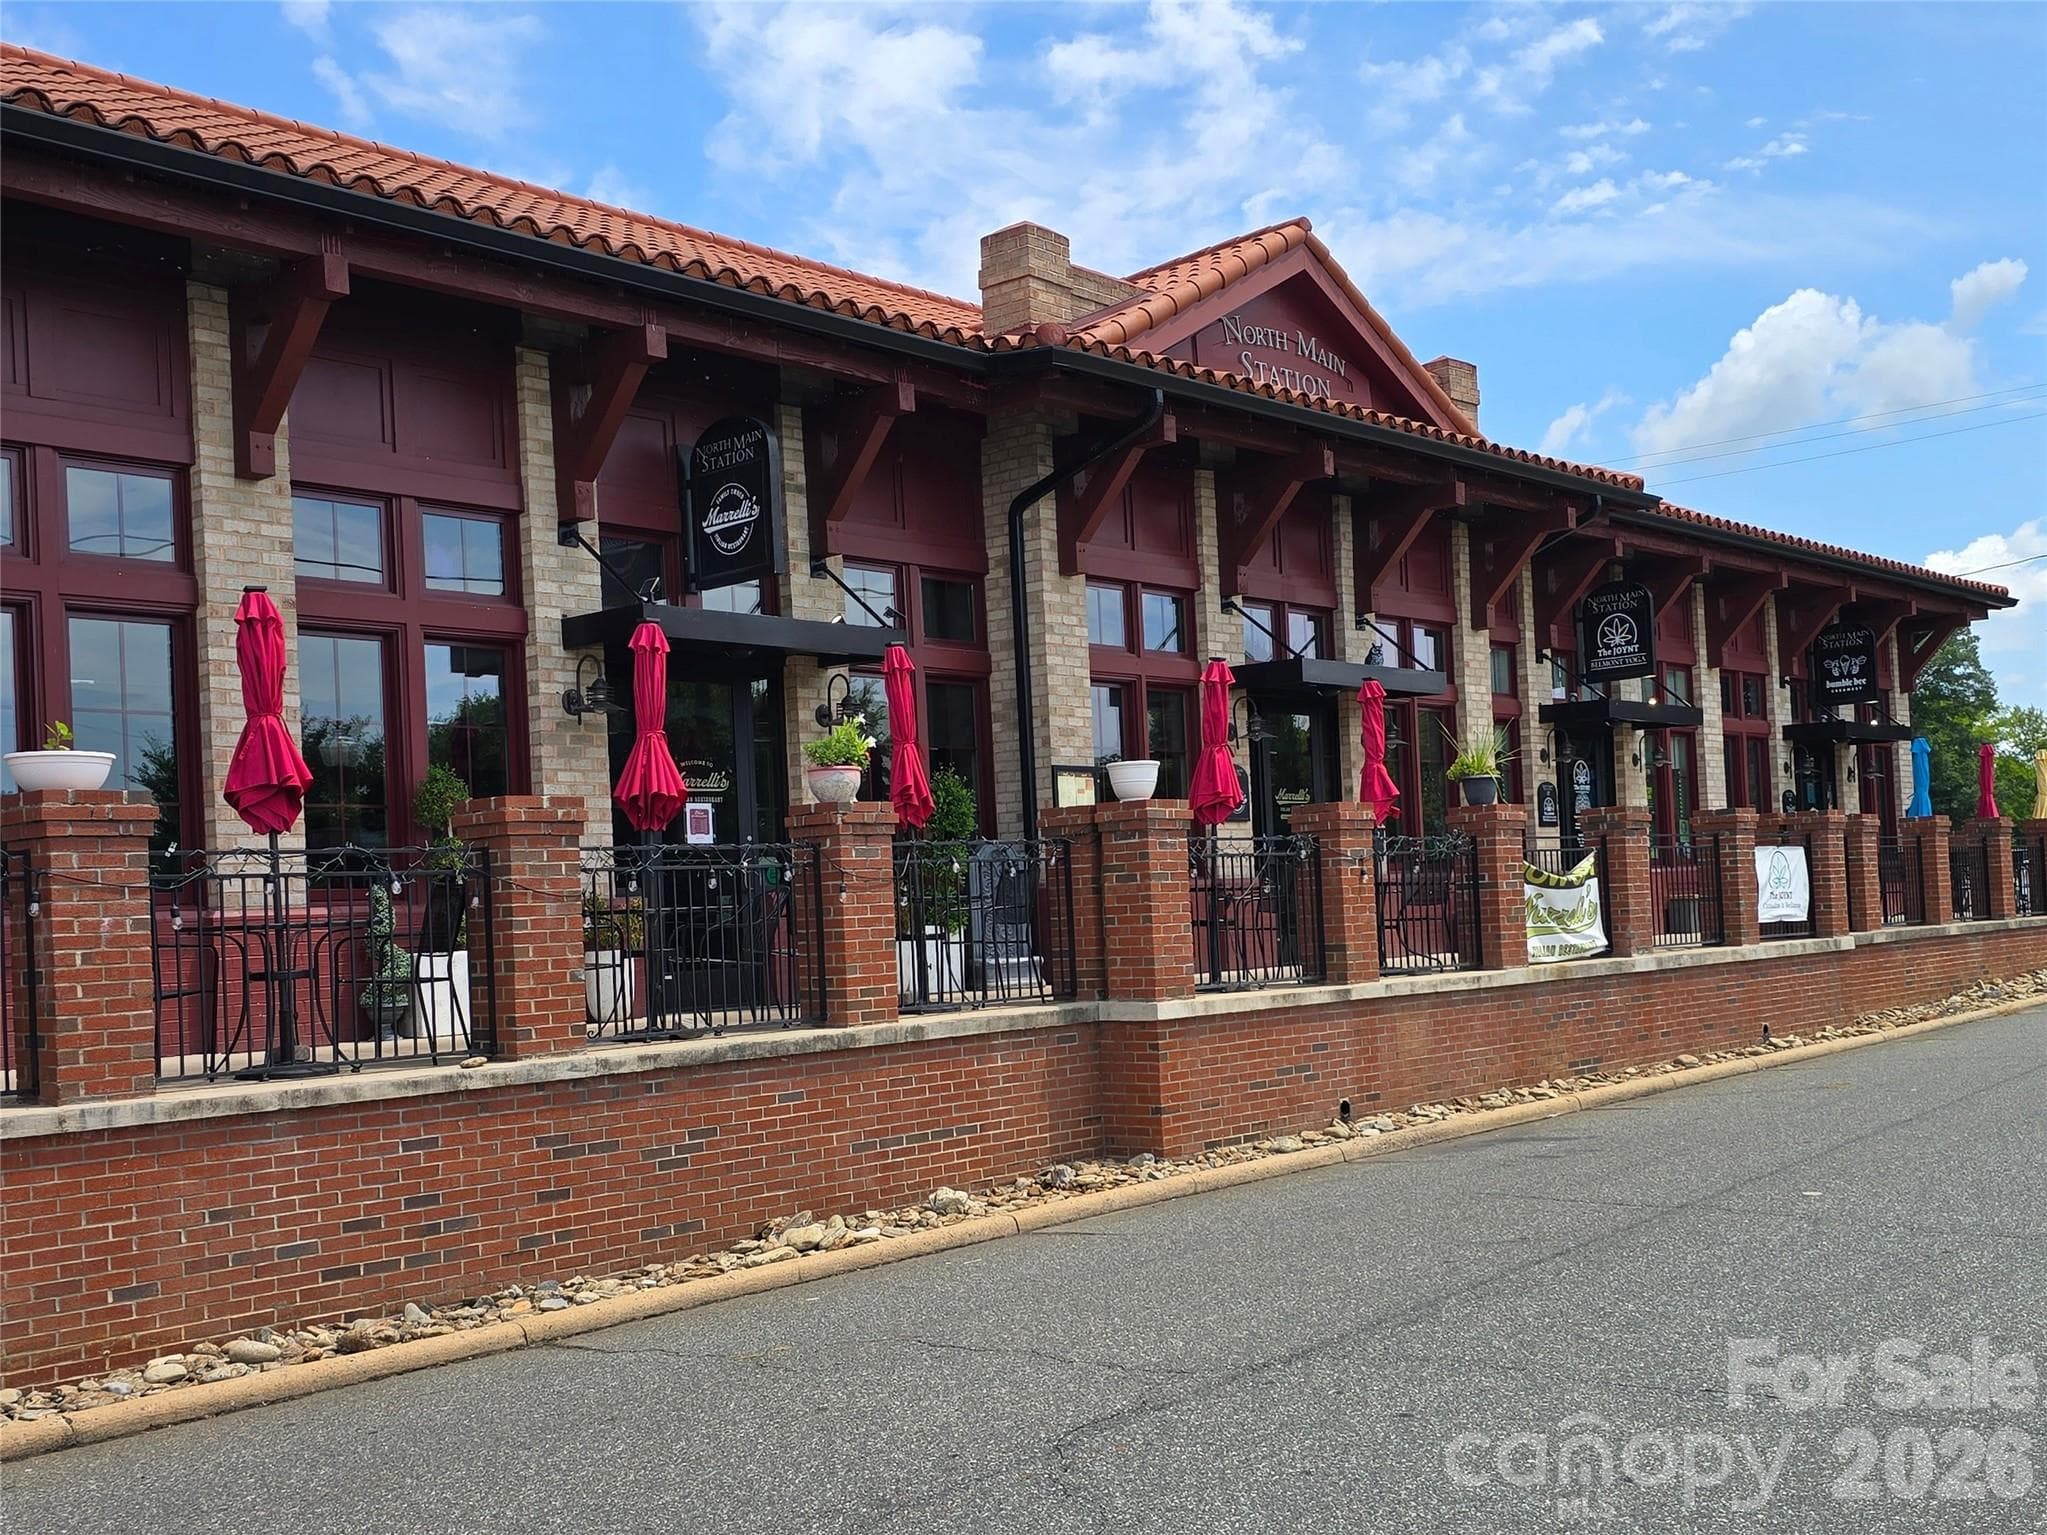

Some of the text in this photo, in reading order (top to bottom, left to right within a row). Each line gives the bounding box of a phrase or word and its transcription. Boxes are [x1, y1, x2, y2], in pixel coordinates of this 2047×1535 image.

[1220, 315, 1346, 377] NORTH MAIN
[1239, 351, 1331, 399] STATION
[696, 429, 763, 463] NORTH MAIN
[701, 446, 755, 473] STATION
[702, 496, 761, 528] Marrelli's
[1588, 589, 1645, 608] NORTH MAIN
[1592, 600, 1638, 614] STATION
[1597, 644, 1639, 657] The JOYNT
